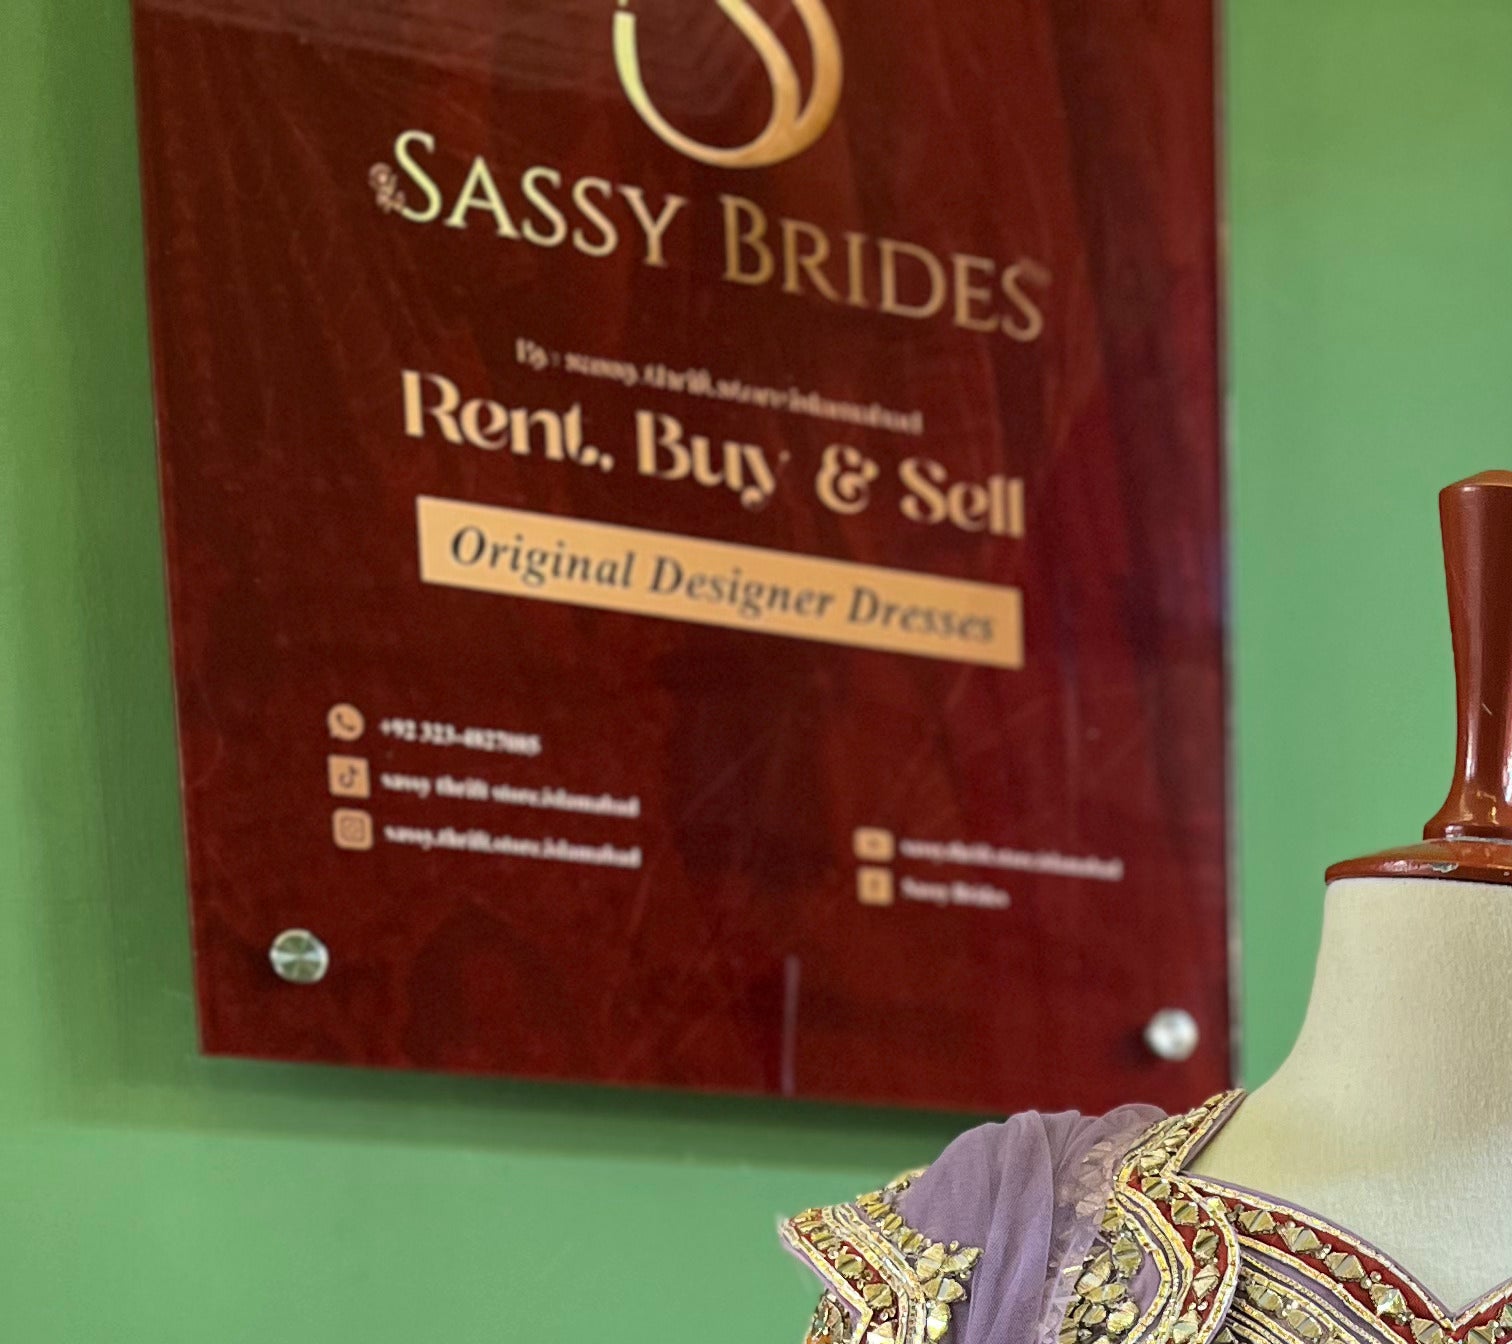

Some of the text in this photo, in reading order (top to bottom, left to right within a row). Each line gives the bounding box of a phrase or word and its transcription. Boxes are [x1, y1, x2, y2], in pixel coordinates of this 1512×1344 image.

[393, 129, 1052, 343] SASSY BRIDES
[633, 409, 792, 509] Buy
[815, 443, 881, 515] &
[898, 457, 1027, 540] Sell
[448, 524, 998, 645] Original Designer Dresses
